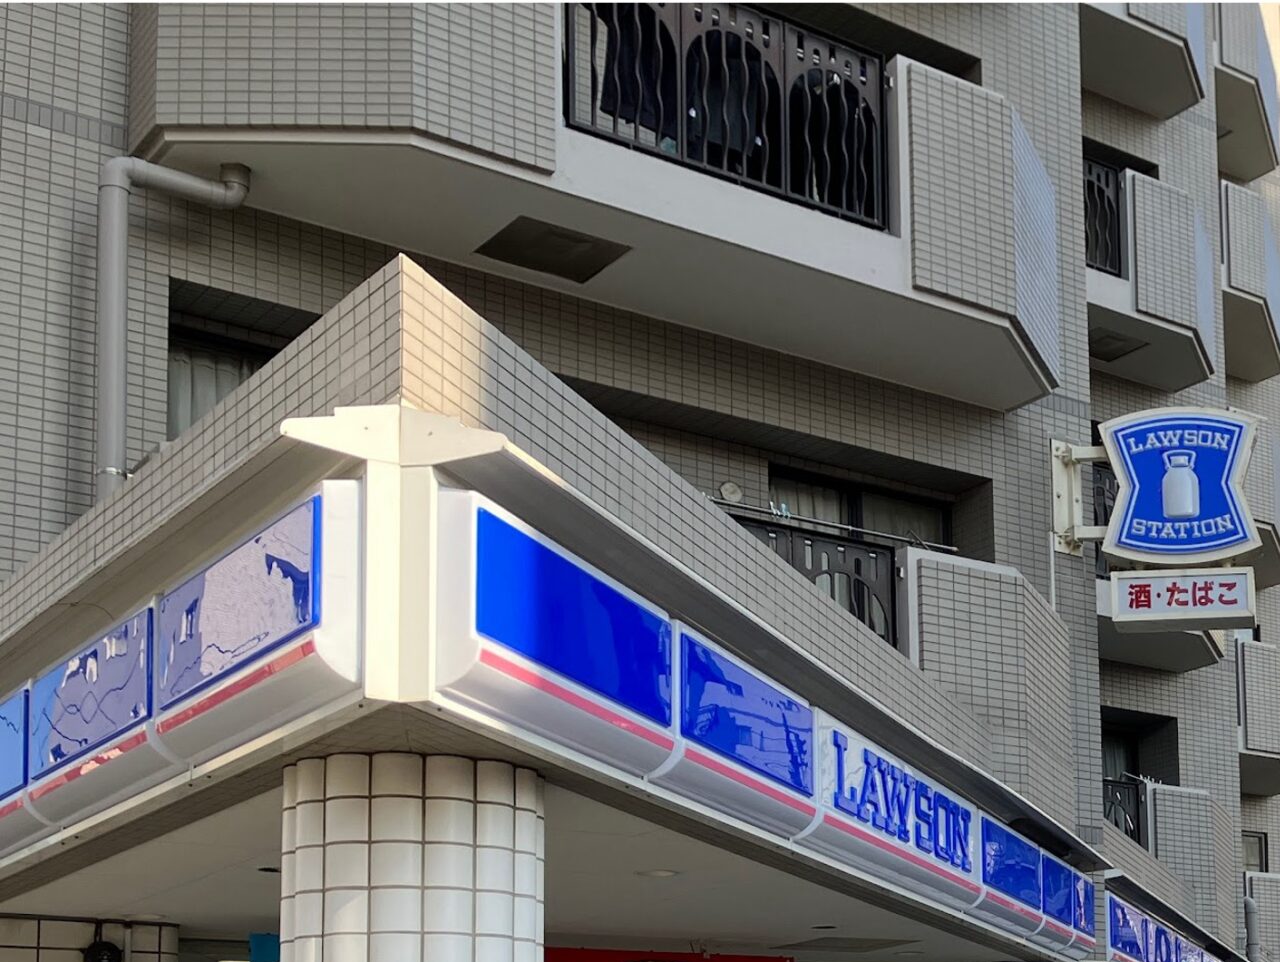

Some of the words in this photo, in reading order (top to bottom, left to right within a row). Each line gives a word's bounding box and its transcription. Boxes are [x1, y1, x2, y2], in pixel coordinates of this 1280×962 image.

[1127, 430, 1231, 454] LAWSON
[1131, 514, 1235, 540] STATION
[1128, 581, 1239, 609] 酒・たばこ
[833, 730, 972, 873] LAWSON
